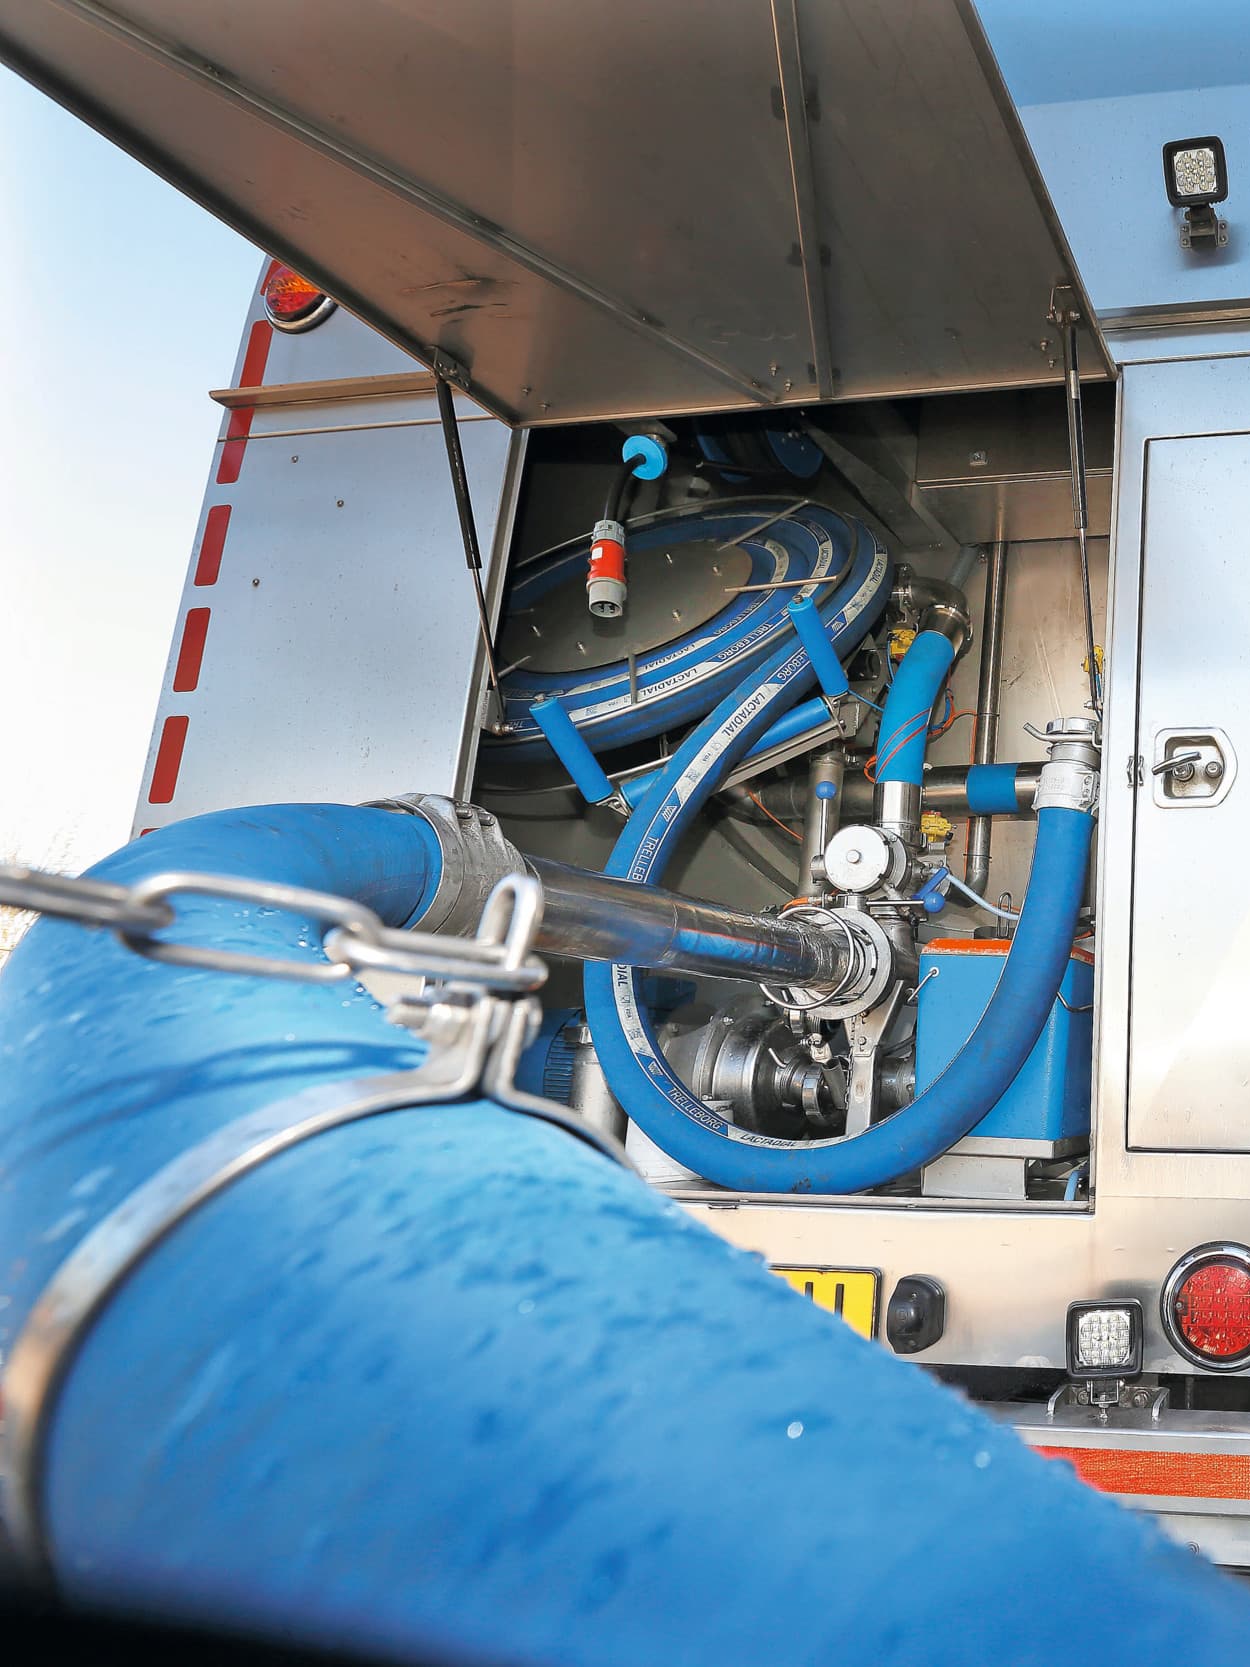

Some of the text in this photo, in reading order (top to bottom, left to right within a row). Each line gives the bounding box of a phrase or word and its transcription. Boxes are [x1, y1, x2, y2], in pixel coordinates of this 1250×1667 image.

[640, 622, 774, 697] TRELLEBORG LACTADIAL
[643, 643, 696, 671] LACTADIAL
[776, 649, 809, 682] LEBORG
[724, 692, 766, 738] LACTADIAL
[632, 836, 660, 881] TRELLEB
[667, 1087, 724, 1130] TRELLEBORG
